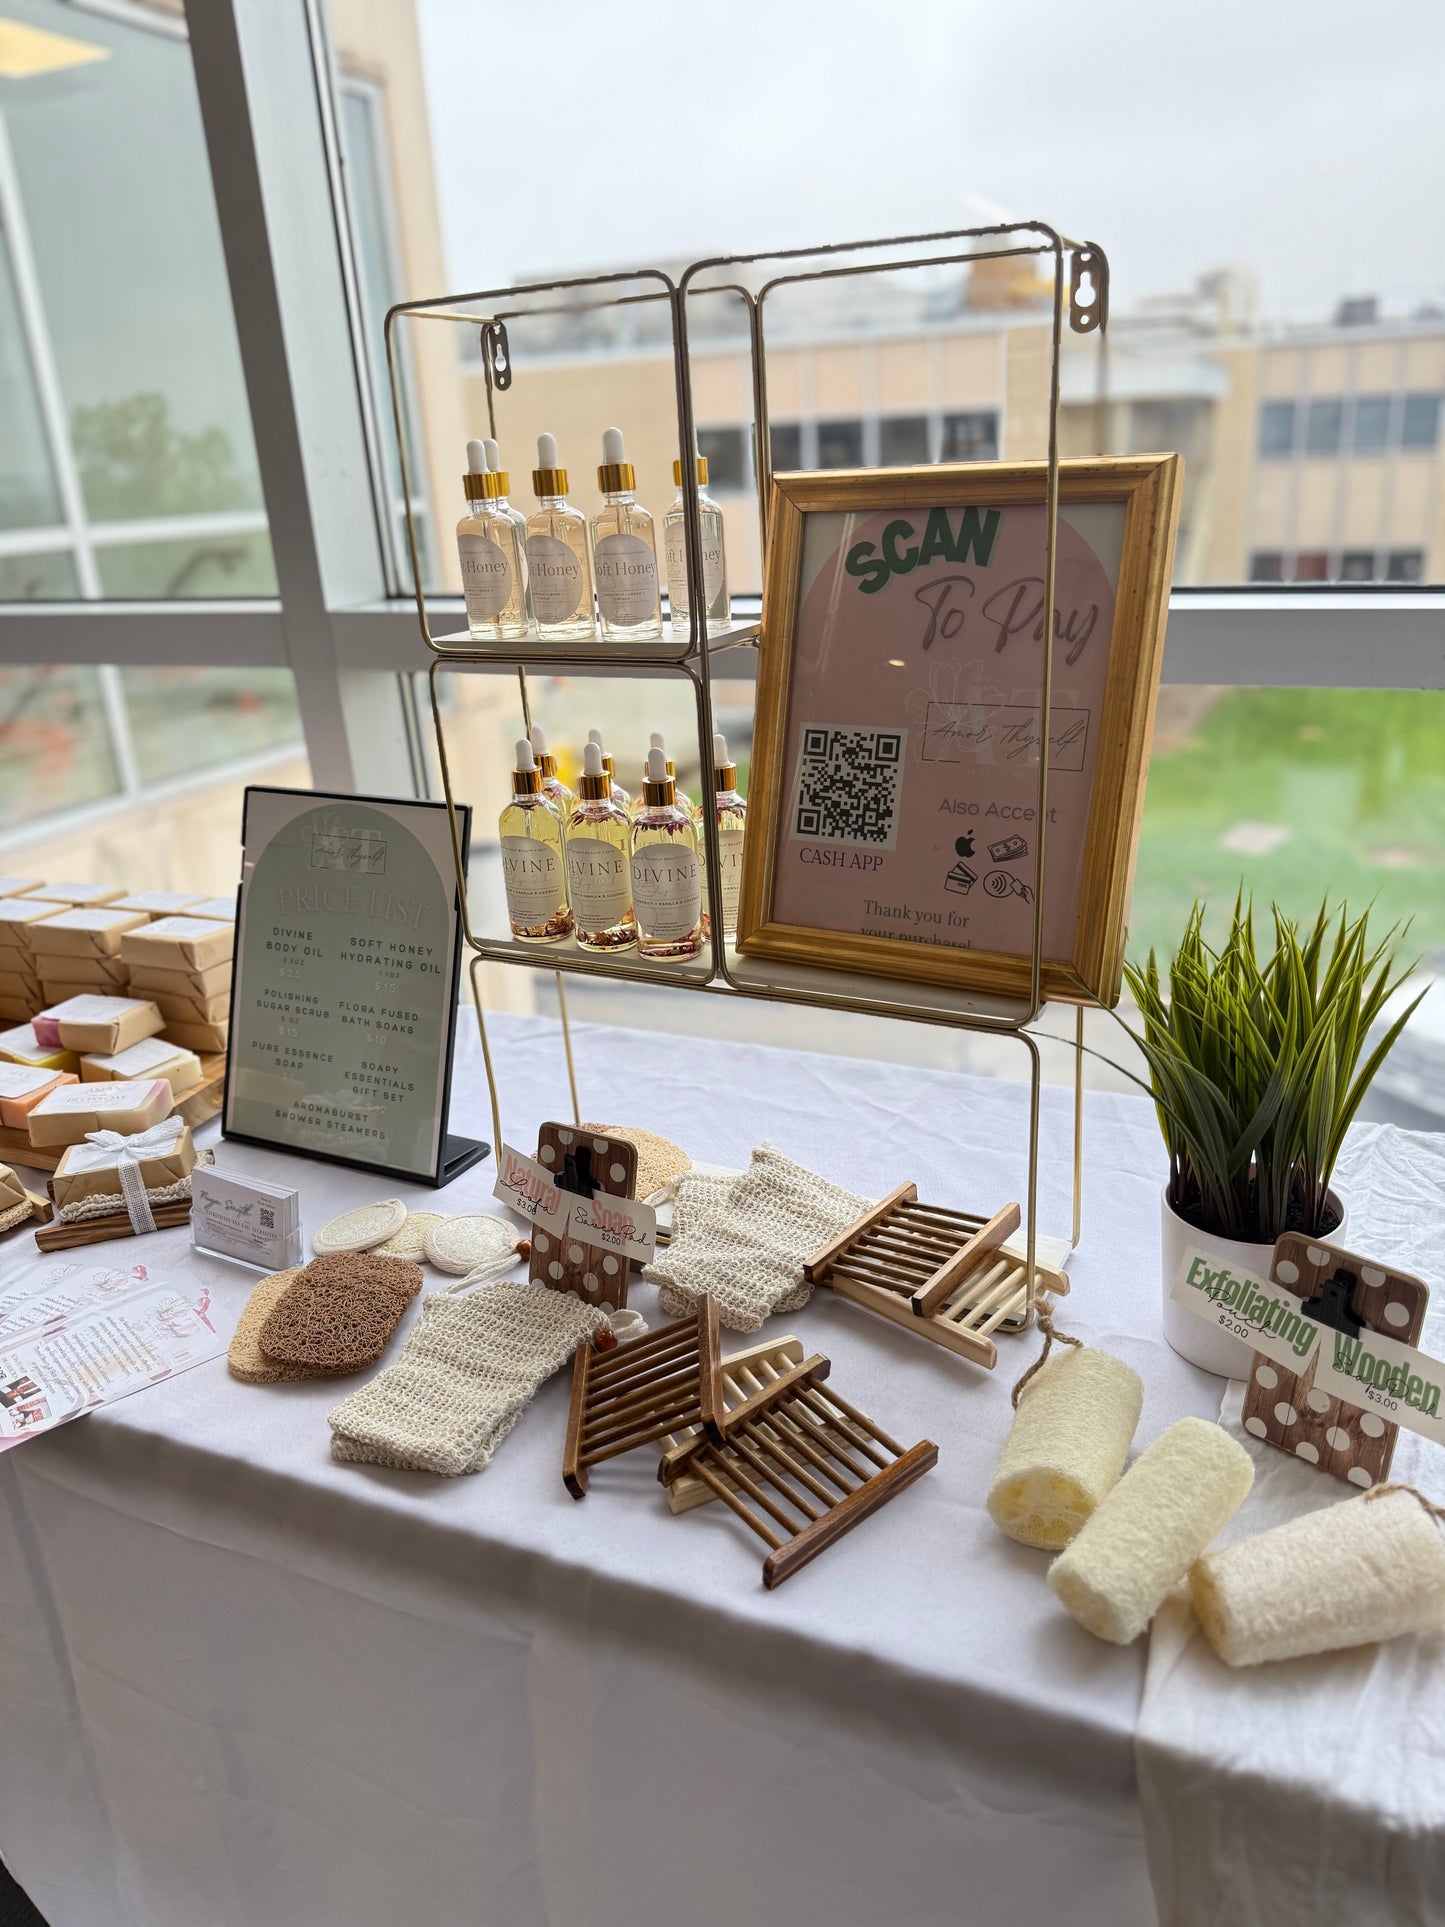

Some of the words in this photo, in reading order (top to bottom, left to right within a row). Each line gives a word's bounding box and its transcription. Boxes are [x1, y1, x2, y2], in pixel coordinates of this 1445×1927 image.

[665, 549, 676, 563] oft
[679, 548, 721, 564] Hney
[845, 506, 1001, 594] SCAN
[467, 561, 508, 576] Honey
[537, 563, 580, 579] Honey
[615, 562, 656, 578] Honey
[914, 575, 976, 651] To
[982, 577, 1098, 666] Pay
[938, 797, 979, 817] Also
[502, 857, 555, 876] IVINE
[800, 848, 845, 869] CASH
[850, 854, 884, 872] APP
[633, 862, 697, 883] DIVINE
[279, 885, 359, 916] PRICE
[368, 889, 430, 929] LIST
[864, 899, 911, 920] Thank
[914, 910, 942, 925] you
[948, 910, 970, 928] for
[272, 927, 314, 941] DIVINE
[266, 941, 298, 954] BODY
[304, 946, 324, 958] OIL
[350, 937, 384, 949] SOFT
[390, 942, 433, 957] HONEY
[279, 967, 302, 979] $25
[340, 951, 413, 970] HYDRATING
[420, 962, 442, 974] OIL
[264, 988, 319, 1005] POLISHING
[373, 980, 397, 993] $15
[256, 1000, 290, 1013] SUGAR
[295, 1005, 330, 1020] SCRUB
[339, 1001, 375, 1015] FLORA
[381, 1008, 419, 1022] FUSED
[277, 1025, 299, 1038] $15
[341, 1015, 371, 1028] BATH
[376, 1021, 415, 1035] SOAKS
[251, 1040, 280, 1054] PURE
[284, 1046, 334, 1063] ESSENCE
[275, 1058, 304, 1070] SOAP
[361, 1061, 399, 1075] SOAPY
[344, 1071, 415, 1092] ESSENTIALS
[352, 1086, 378, 1097] GIFT
[383, 1091, 405, 1103] SET
[292, 1100, 369, 1122] AROMABURST
[274, 1109, 321, 1127] SHOWER
[326, 1119, 386, 1140] STEAMERS
[500, 1172, 554, 1215] Loofa
[502, 1154, 563, 1214] Natural
[516, 1198, 537, 1216] $3.00
[574, 1206, 621, 1236] Saver
[619, 1225, 650, 1246] Pad
[591, 1200, 634, 1247] Soap
[601, 1232, 621, 1246] $2.00
[1185, 1256, 1318, 1357] Exfoliating
[1204, 1286, 1277, 1339] Pouch
[1218, 1314, 1249, 1339] $2.00
[1332, 1332, 1441, 1418] Wooden
[1332, 1352, 1377, 1393] Soap
[1386, 1378, 1443, 1420] Dish
[1367, 1389, 1398, 1411] $3.00
